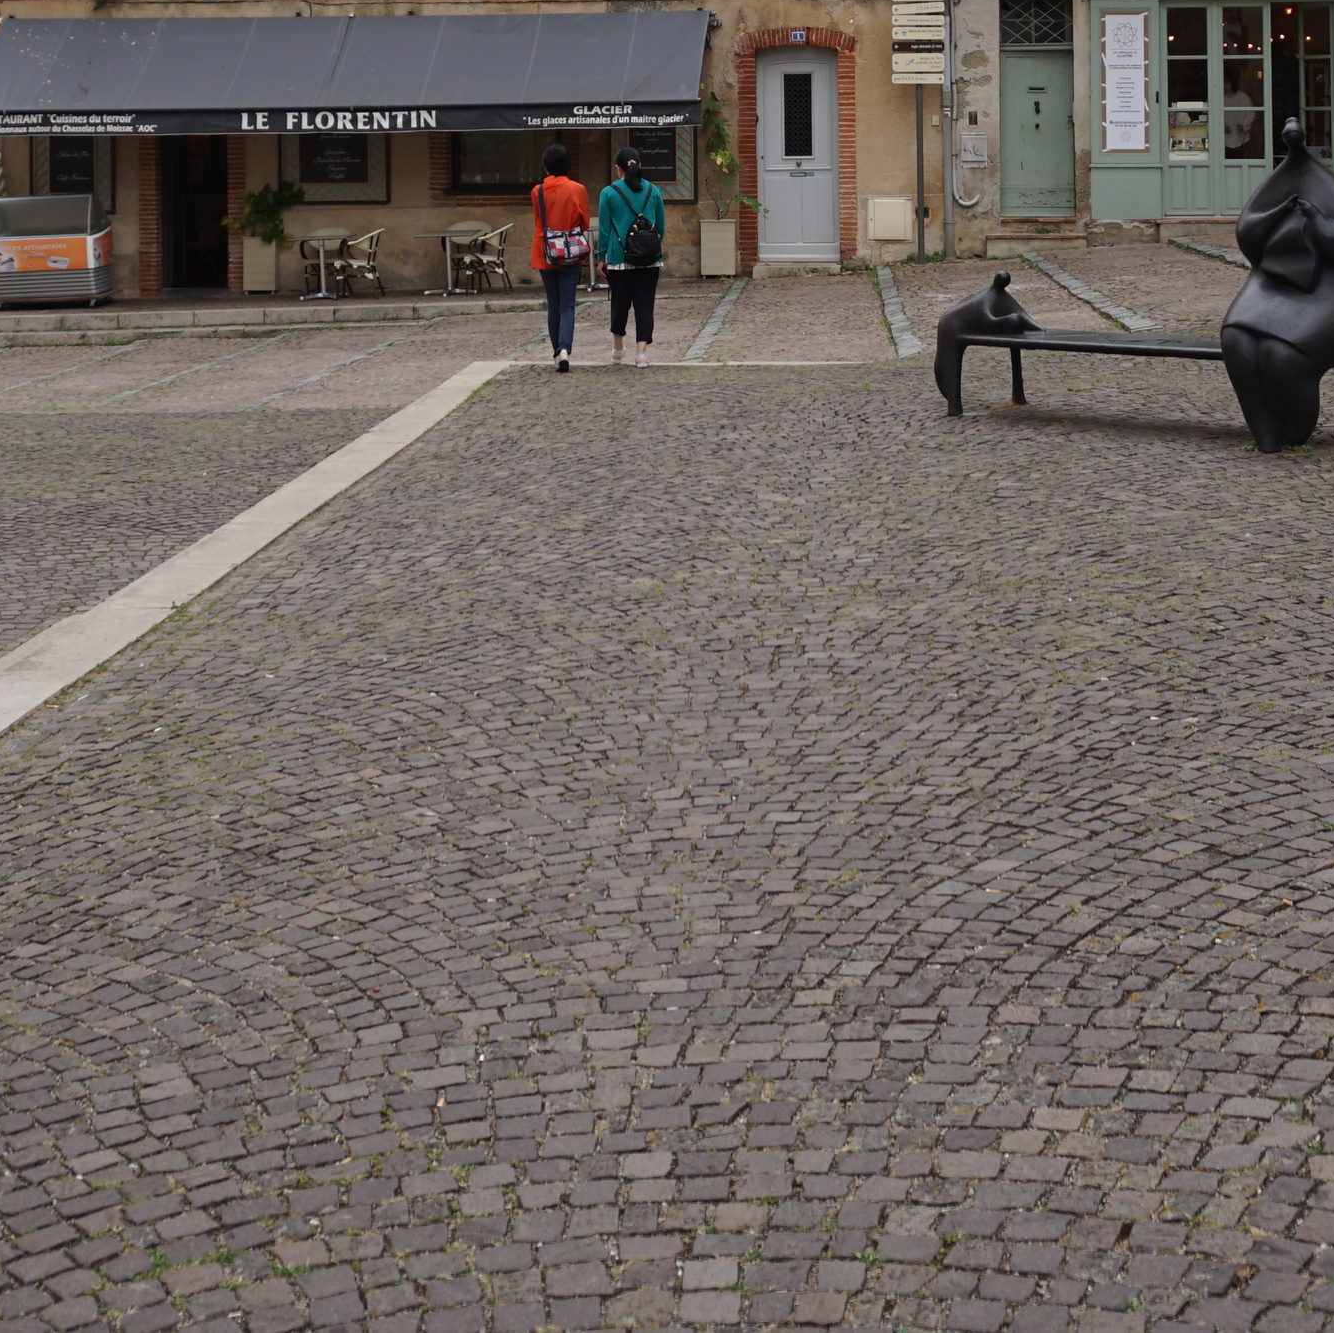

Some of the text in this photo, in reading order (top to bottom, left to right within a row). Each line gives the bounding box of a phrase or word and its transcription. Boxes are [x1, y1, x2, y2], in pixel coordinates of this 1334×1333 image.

[573, 105, 633, 115] GLACIER
[89, 114, 101, 124] du
[241, 110, 437, 130] LE FLORENTIN
[543, 116, 567, 127] glaces
[568, 116, 610, 125] artisanales
[612, 115, 629, 124] d'un
[28, 125, 51, 133] autour
[52, 125, 61, 133] du
[62, 125, 95, 133] Chasselas
[96, 125, 106, 133] de
[107, 125, 133, 133] Moissac
[23, 242, 67, 251] artisanales
